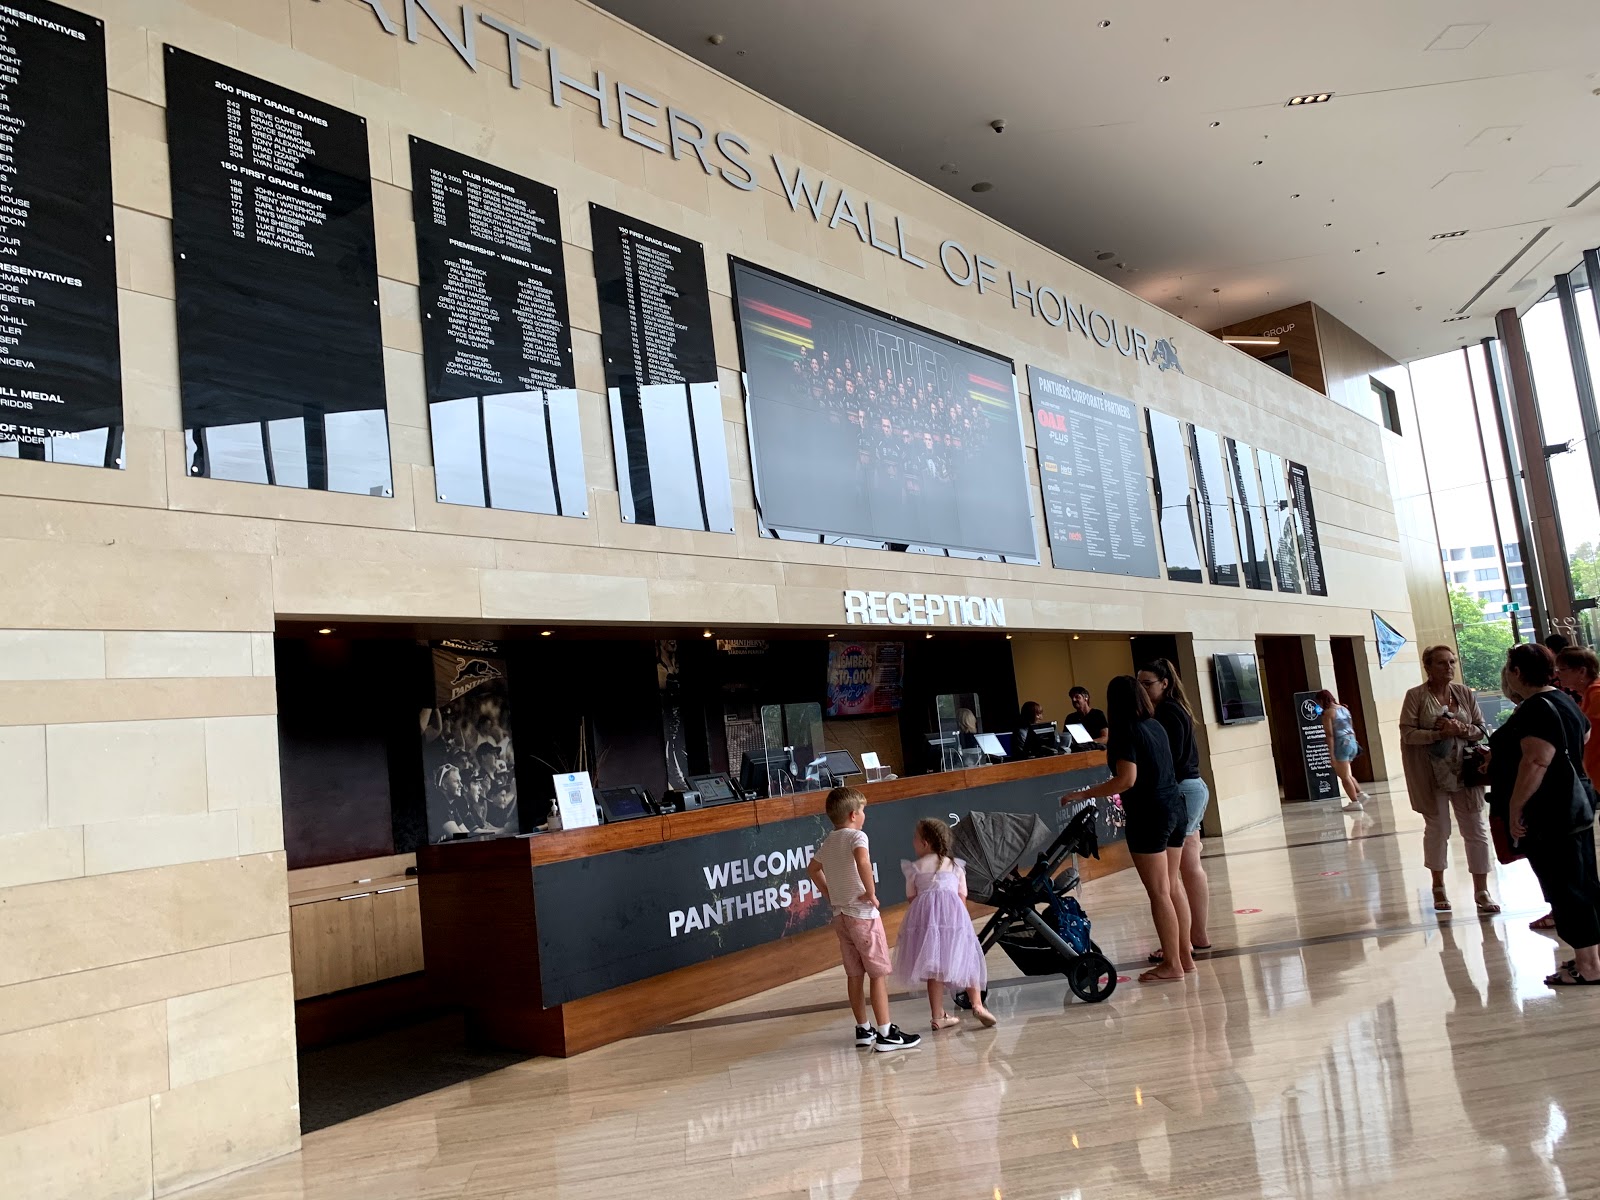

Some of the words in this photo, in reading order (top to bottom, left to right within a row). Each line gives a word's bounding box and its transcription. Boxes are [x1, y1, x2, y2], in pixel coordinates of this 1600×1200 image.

[215, 81, 234, 93] 200
[236, 88, 262, 102] FIRST
[264, 99, 295, 115] GRADE
[297, 111, 328, 127] GAMES
[227, 100, 240, 109] 242
[250, 108, 272, 120] STEVE
[274, 117, 302, 131] CARTER
[227, 107, 241, 116] 238
[251, 115, 273, 127] CRAIG
[275, 124, 302, 137] GOWER
[227, 114, 240, 122] 237
[251, 122, 276, 135] ROYCE
[278, 131, 311, 147] SIMMONS
[228, 121, 242, 130] 228
[252, 129, 272, 141] GREG
[274, 137, 315, 155] ALEXANDER
[228, 128, 239, 136] 211
[252, 136, 272, 147] TONY
[274, 144, 306, 159] PULETUA
[229, 135, 242, 145] 209
[252, 143, 273, 154] BRAD
[274, 151, 299, 163] IZZARD
[229, 143, 243, 152] 208
[253, 150, 271, 161] LUKE
[273, 157, 295, 169] LEWIS
[230, 150, 243, 159] 204
[253, 157, 272, 168] RYAN
[274, 164, 304, 178] GIRDLER
[221, 161, 238, 171] 150
[240, 167, 266, 180] FIRST
[268, 176, 299, 191] GRADE
[301, 186, 332, 201] GAMES
[312, 0, 758, 191] NTHERS
[772, 153, 928, 269] WALL
[939, 239, 998, 295] OF
[1008, 269, 1153, 366] HONOUR
[462, 170, 481, 181] CLUB
[482, 177, 515, 193] HONOURS
[467, 187, 481, 196] FIRST
[254, 187, 275, 197] JOHN
[277, 193, 322, 211] CARTWRIGHT
[467, 181, 481, 190] FIRST
[501, 193, 526, 206] PREMIERS
[231, 200, 242, 208] 177
[255, 207, 275, 218] RHYS
[276, 214, 305, 227] WESSER
[255, 193, 278, 204] TRENT
[280, 201, 326, 219] WATERHOUSE
[255, 200, 274, 211] CARL
[276, 207, 322, 225] MACNAMARA
[468, 193, 482, 202] FIRST
[520, 212, 545, 224] PREMIERS
[484, 205, 504, 216] SEASON
[256, 214, 269, 223] TIM
[271, 219, 299, 232] SHEENS
[256, 222, 275, 232] LUKE
[277, 228, 304, 240] PRIDDIS
[469, 212, 482, 220] NEW
[483, 216, 501, 226] SOUTH
[502, 223, 519, 232] WALES
[532, 232, 556, 244] PREMIERS
[233, 230, 245, 238] 152
[257, 236, 281, 248] FRANK
[283, 243, 315, 257] PULETUA
[256, 229, 275, 239] MATT
[276, 235, 312, 249] ADAMSON
[470, 224, 492, 235] HOLDEN
[506, 235, 531, 247] PREMIERS
[471, 230, 493, 241] HOLDEN
[506, 241, 531, 253] PREMIERS
[503, 229, 529, 241] PREMIERS
[629, 230, 644, 239] FIRST
[663, 243, 681, 253] GAMES
[444, 260, 460, 269] GREG
[449, 239, 495, 256] PREMIERSHIP
[501, 254, 529, 267] WINNING
[531, 263, 552, 274] TEAMS
[459, 258, 472, 266] 1991
[448, 273, 460, 281] COL
[461, 277, 485, 287] BENTLEY
[448, 279, 464, 288] BRAD
[450, 267, 464, 276] PAUL
[465, 272, 483, 281] SMITH
[528, 278, 542, 286] 2003
[437, 302, 455, 311] COLIN
[456, 306, 468, 314] VAN
[448, 292, 465, 301] STEVE
[467, 297, 488, 307] CARTER
[457, 301, 489, 313] ALEXANDER
[451, 312, 468, 320] MARK
[469, 322, 492, 332] WALKER
[452, 324, 467, 332] PAUL
[1263, 323, 1295, 338] GROUP
[456, 338, 470, 346] PAUL
[471, 341, 488, 349] DUNN
[455, 356, 471, 364] BRAD
[457, 351, 488, 362] Interchange
[464, 365, 500, 377] CARTWRIGHT
[469, 372, 482, 380] PHIL
[483, 375, 503, 384] GOULD
[20, 389, 65, 404] MEDAL
[1038, 377, 1071, 399] PANTHERS
[1071, 388, 1104, 410] CORPORATE
[1104, 399, 1131, 419] PARTNERS
[0, 423, 17, 433] OF
[19, 425, 45, 437] THE
[47, 429, 81, 441] YEAR
[843, 589, 1007, 628] RECEPTION
[832, 654, 874, 669] MEMBERS
[831, 668, 873, 687] $10,000
[1055, 807, 1071, 823] NRL
[1071, 796, 1097, 817] MINOR
[703, 844, 816, 890] WELCOME
[668, 883, 793, 938] PANTHERS
